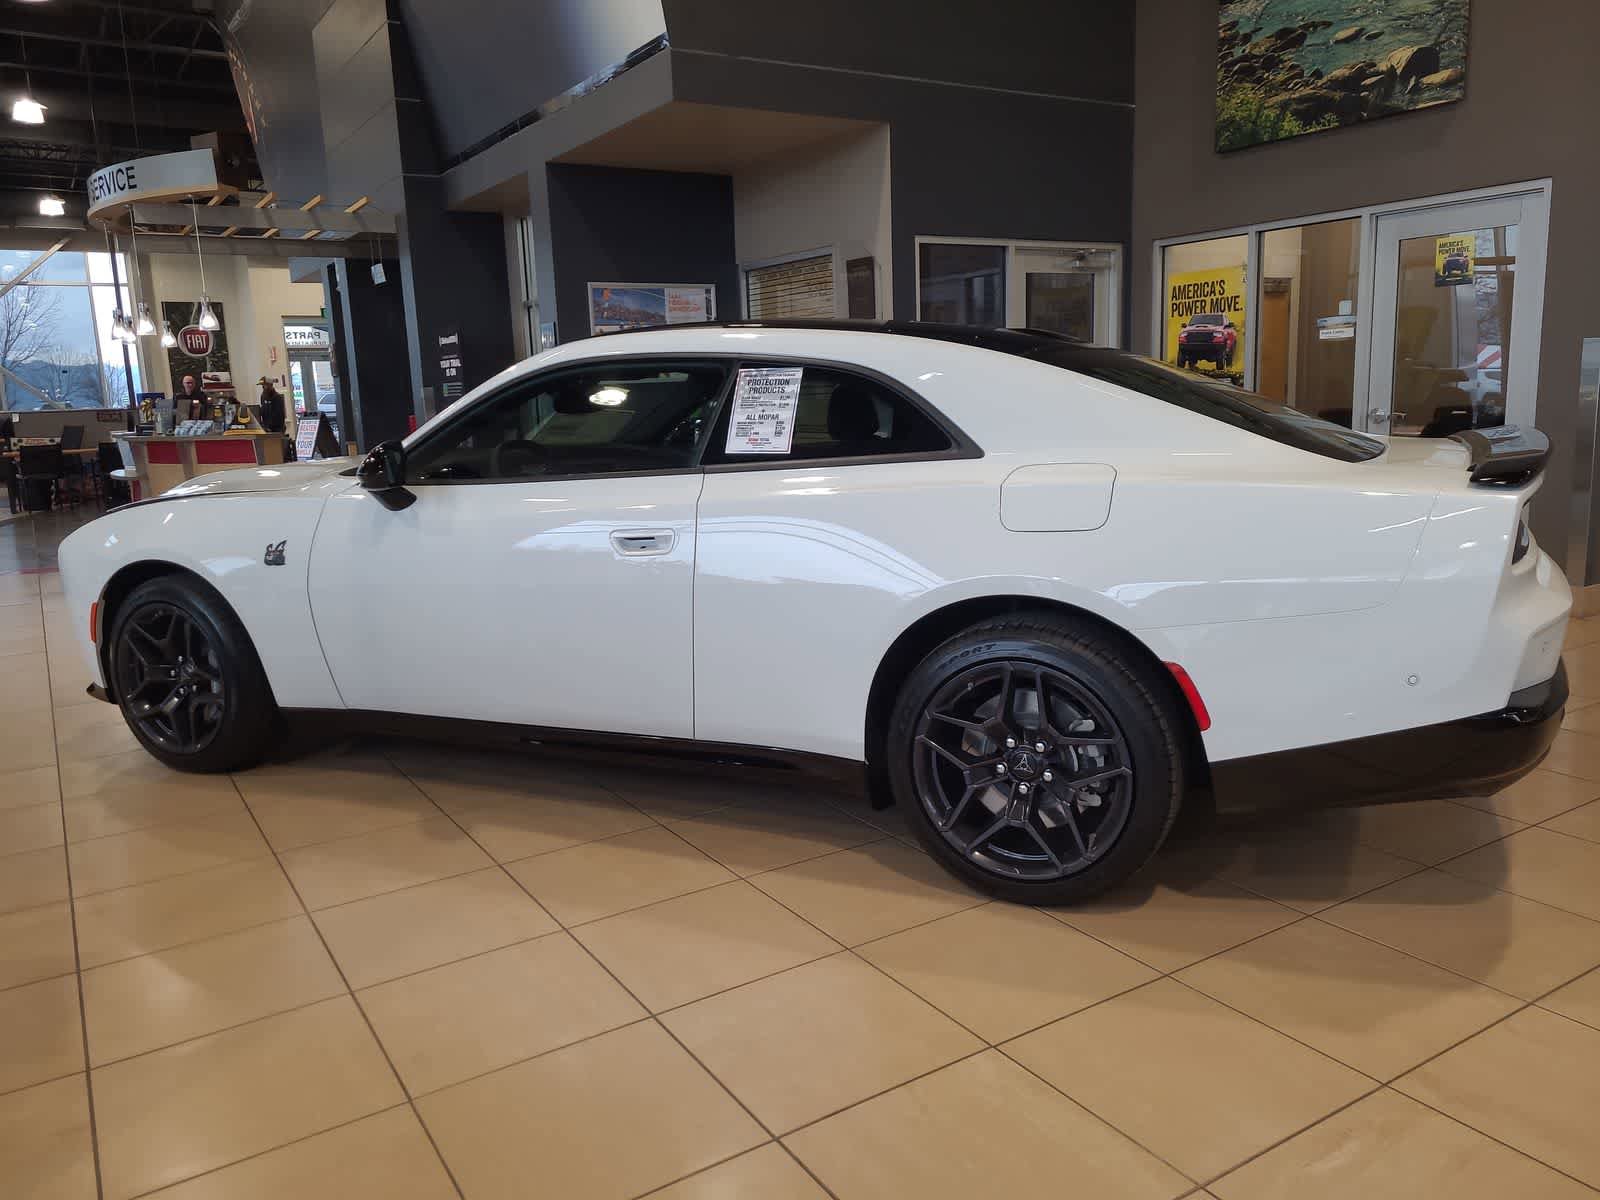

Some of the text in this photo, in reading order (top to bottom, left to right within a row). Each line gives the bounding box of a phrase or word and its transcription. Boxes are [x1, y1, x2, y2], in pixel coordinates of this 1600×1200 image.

[88, 167, 137, 202] SERVICE
[1171, 279, 1226, 301] AMERICA'S
[1171, 295, 1243, 318] POWER MOVE.
[186, 334, 208, 350] FIAT
[747, 378, 791, 387] PROTECTION
[748, 386, 786, 395] PRODUCTS
[746, 413, 780, 421] ALL MOPAR
